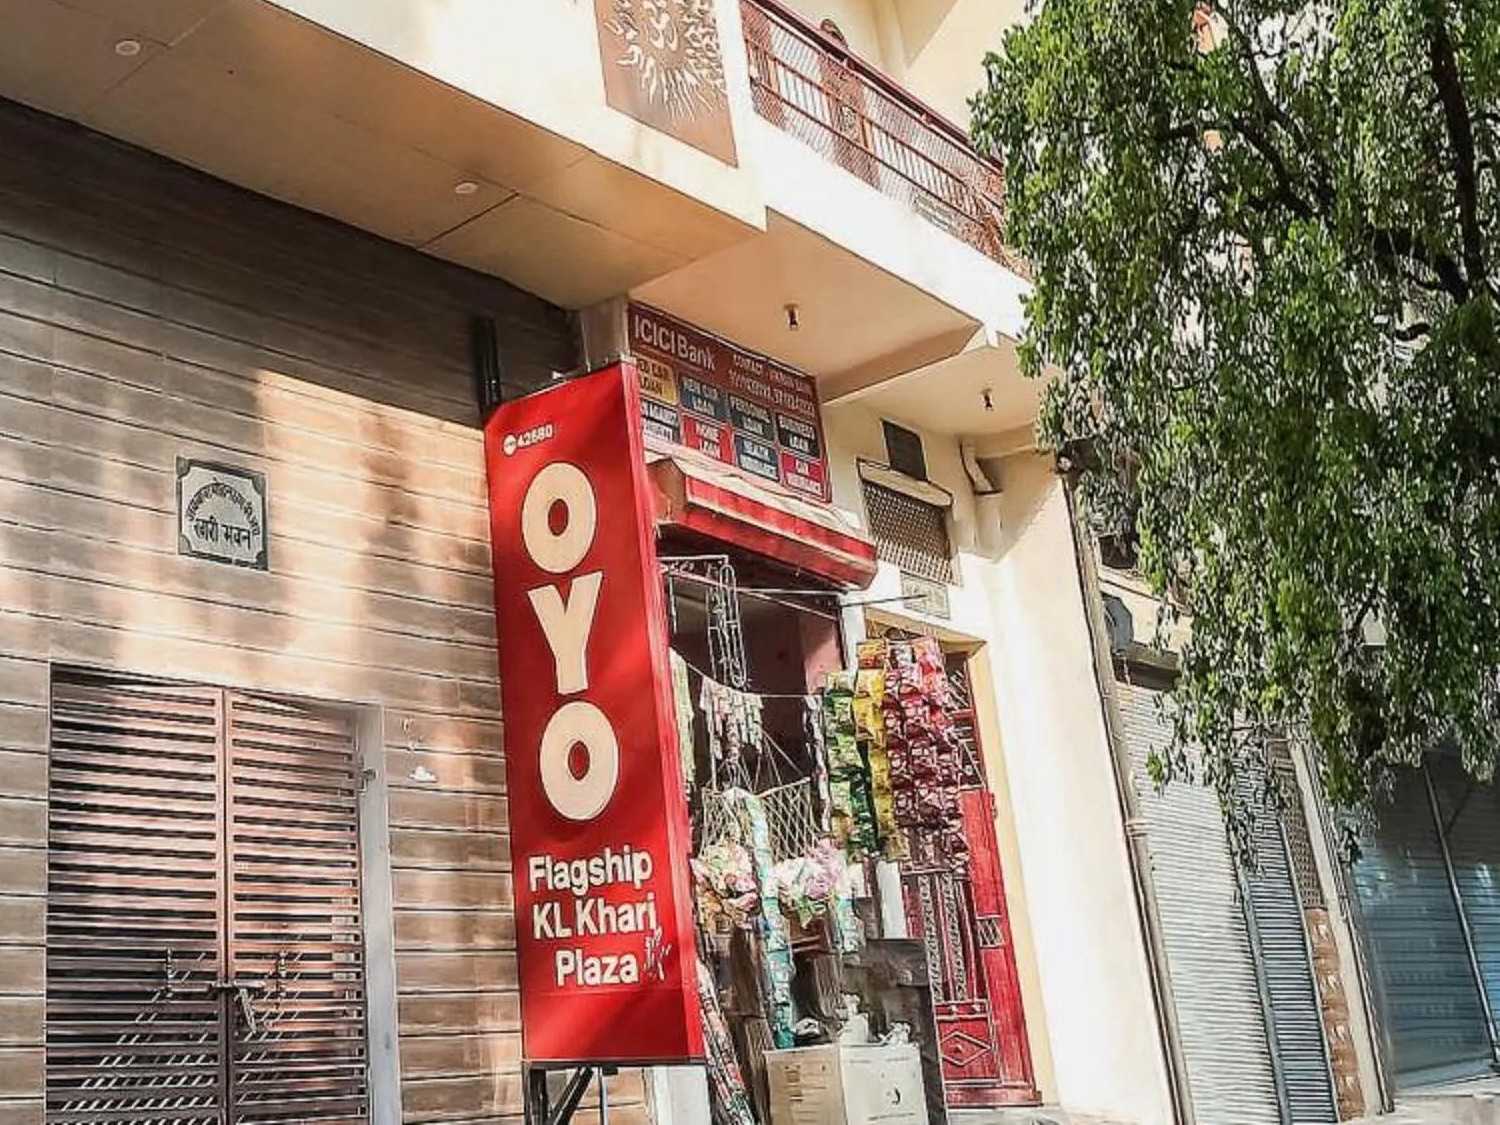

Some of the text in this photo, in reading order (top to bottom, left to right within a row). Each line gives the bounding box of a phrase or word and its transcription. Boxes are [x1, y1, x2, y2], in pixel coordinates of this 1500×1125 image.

[634, 314, 716, 372] ICICI Bank
[521, 461, 619, 822] OYO
[528, 845, 653, 895] Flagship
[532, 892, 657, 940] KL Khari
[555, 948, 639, 987] Plaza
